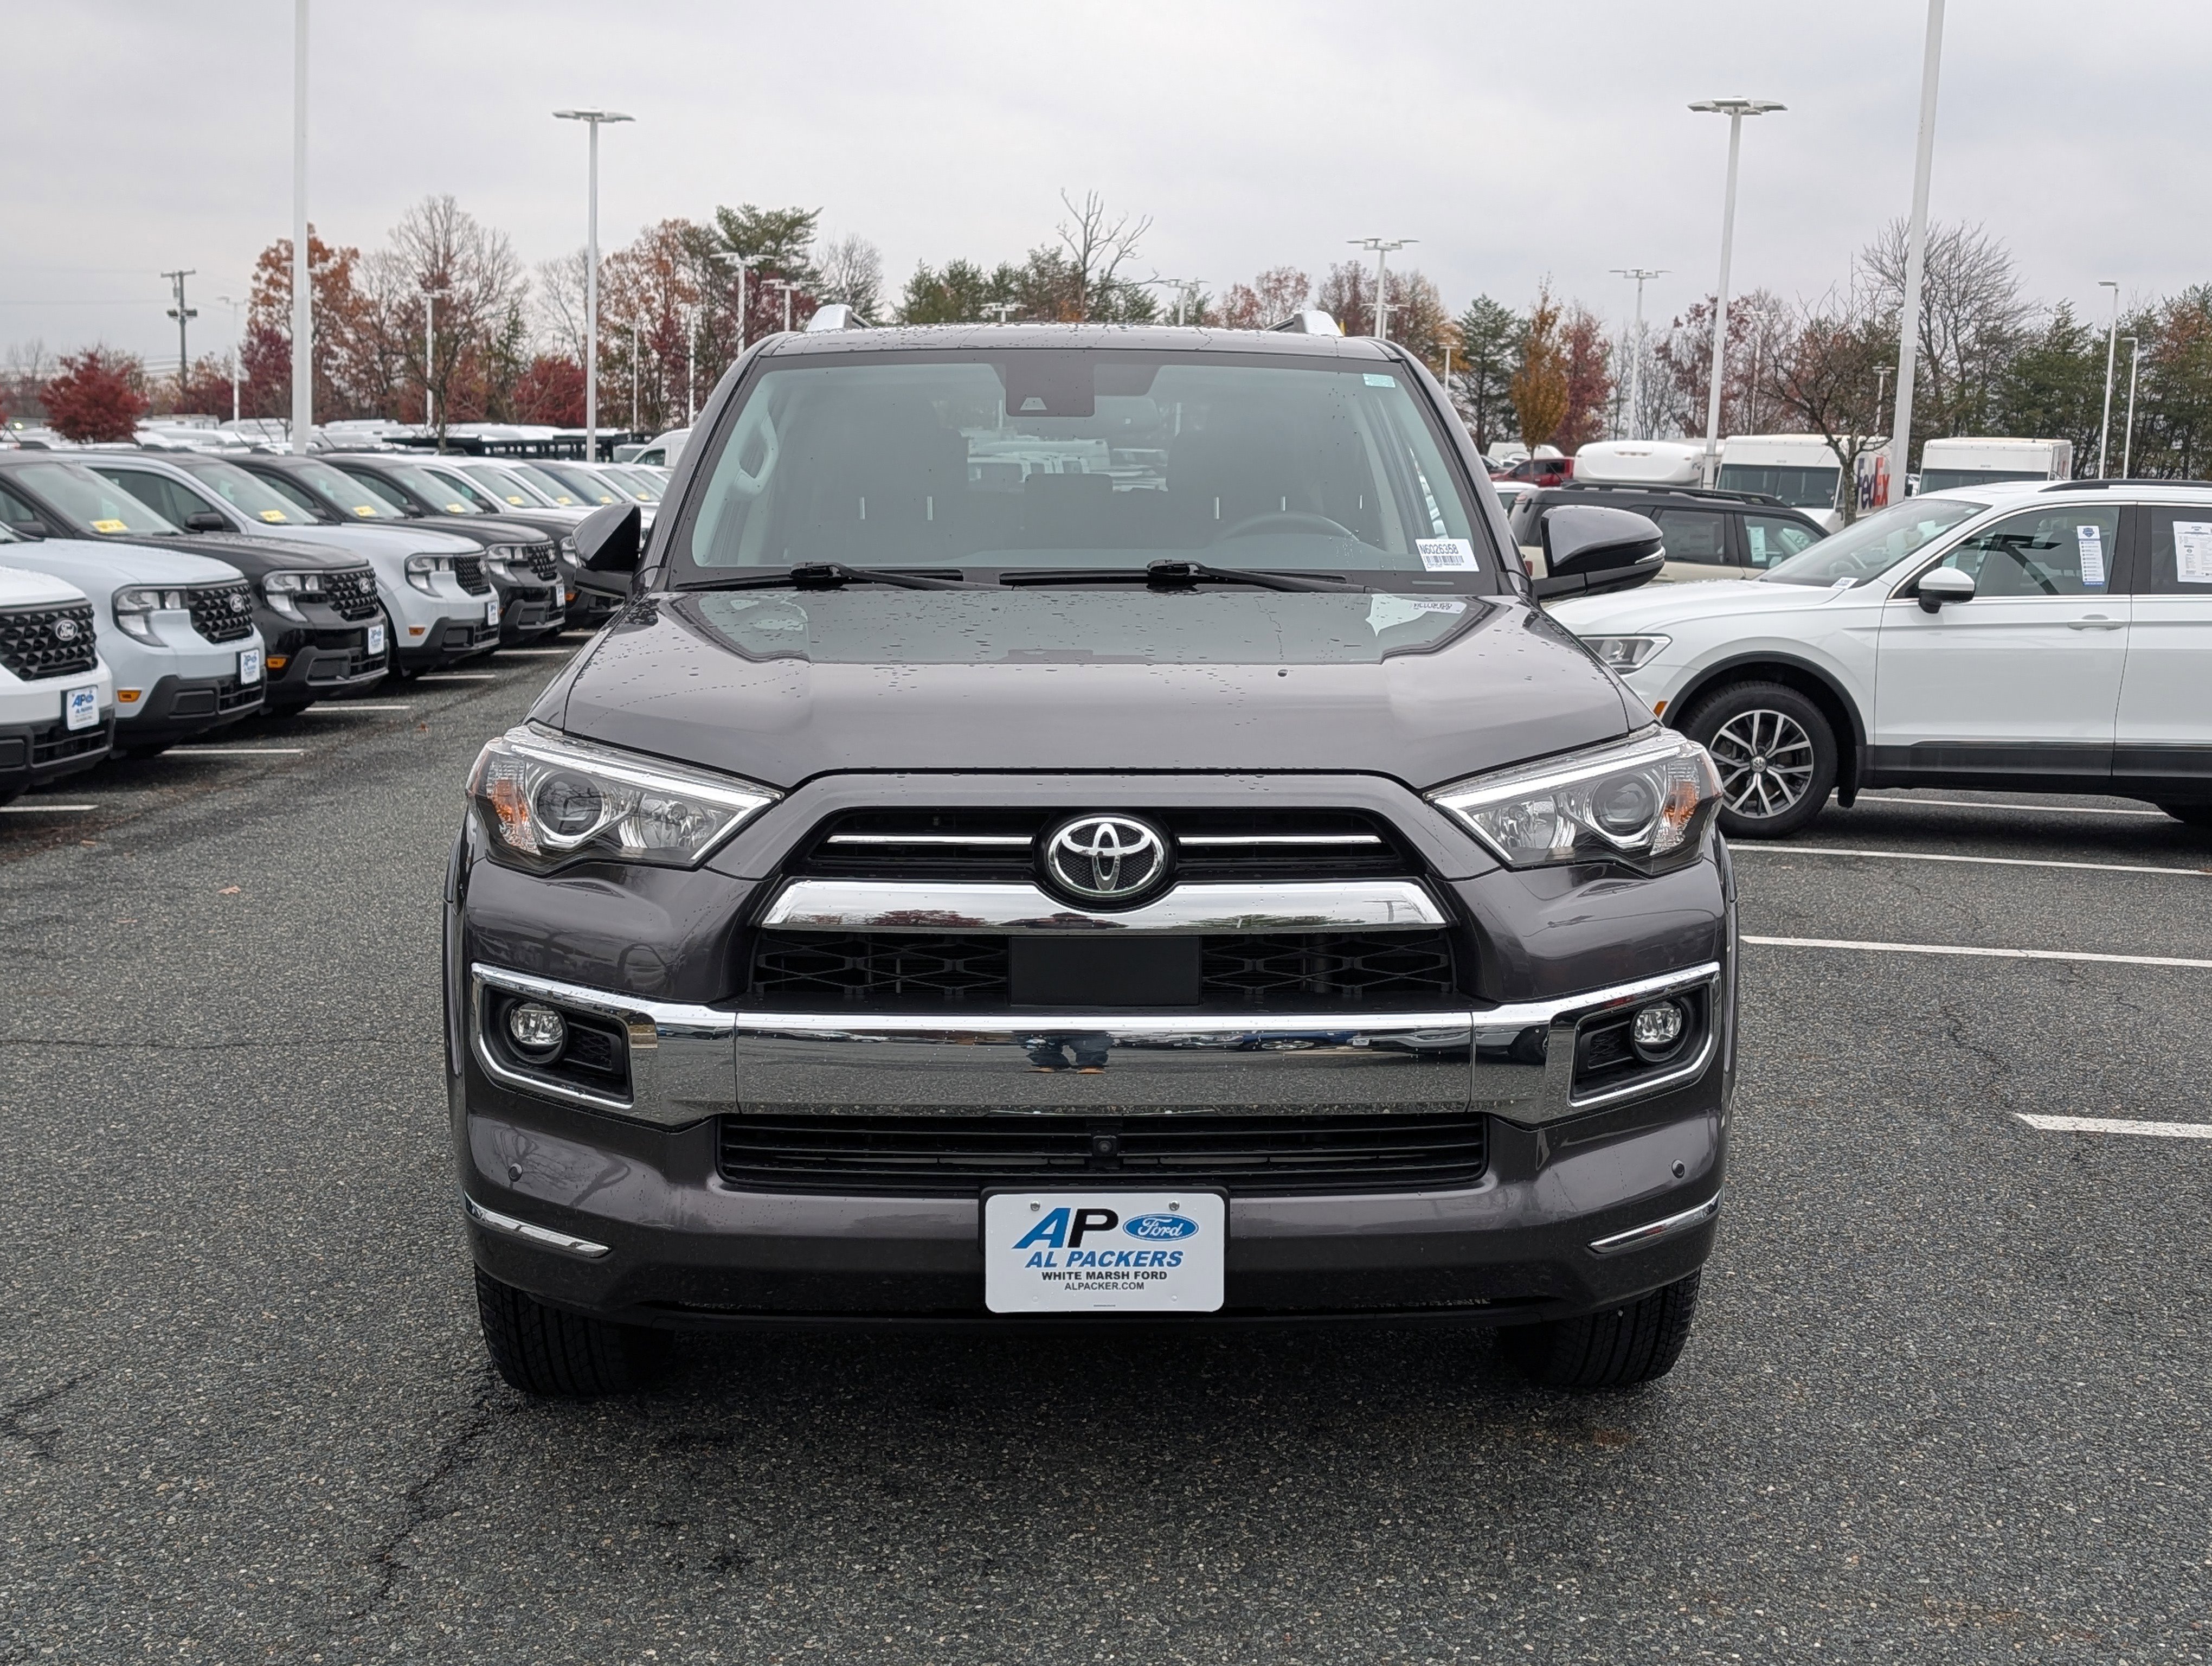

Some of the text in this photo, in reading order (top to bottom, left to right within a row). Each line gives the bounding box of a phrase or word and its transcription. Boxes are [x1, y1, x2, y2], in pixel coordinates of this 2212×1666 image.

[1857, 457, 1890, 509] FedEx
[1419, 543, 1459, 554] N6026358
[1012, 1208, 1184, 1249] AP Ford
[1024, 1251, 1184, 1268] AL PACKERS
[1041, 1271, 1167, 1280] WHITE MARSH FORD
[1064, 1281, 1144, 1291] ALPACKER.COM
